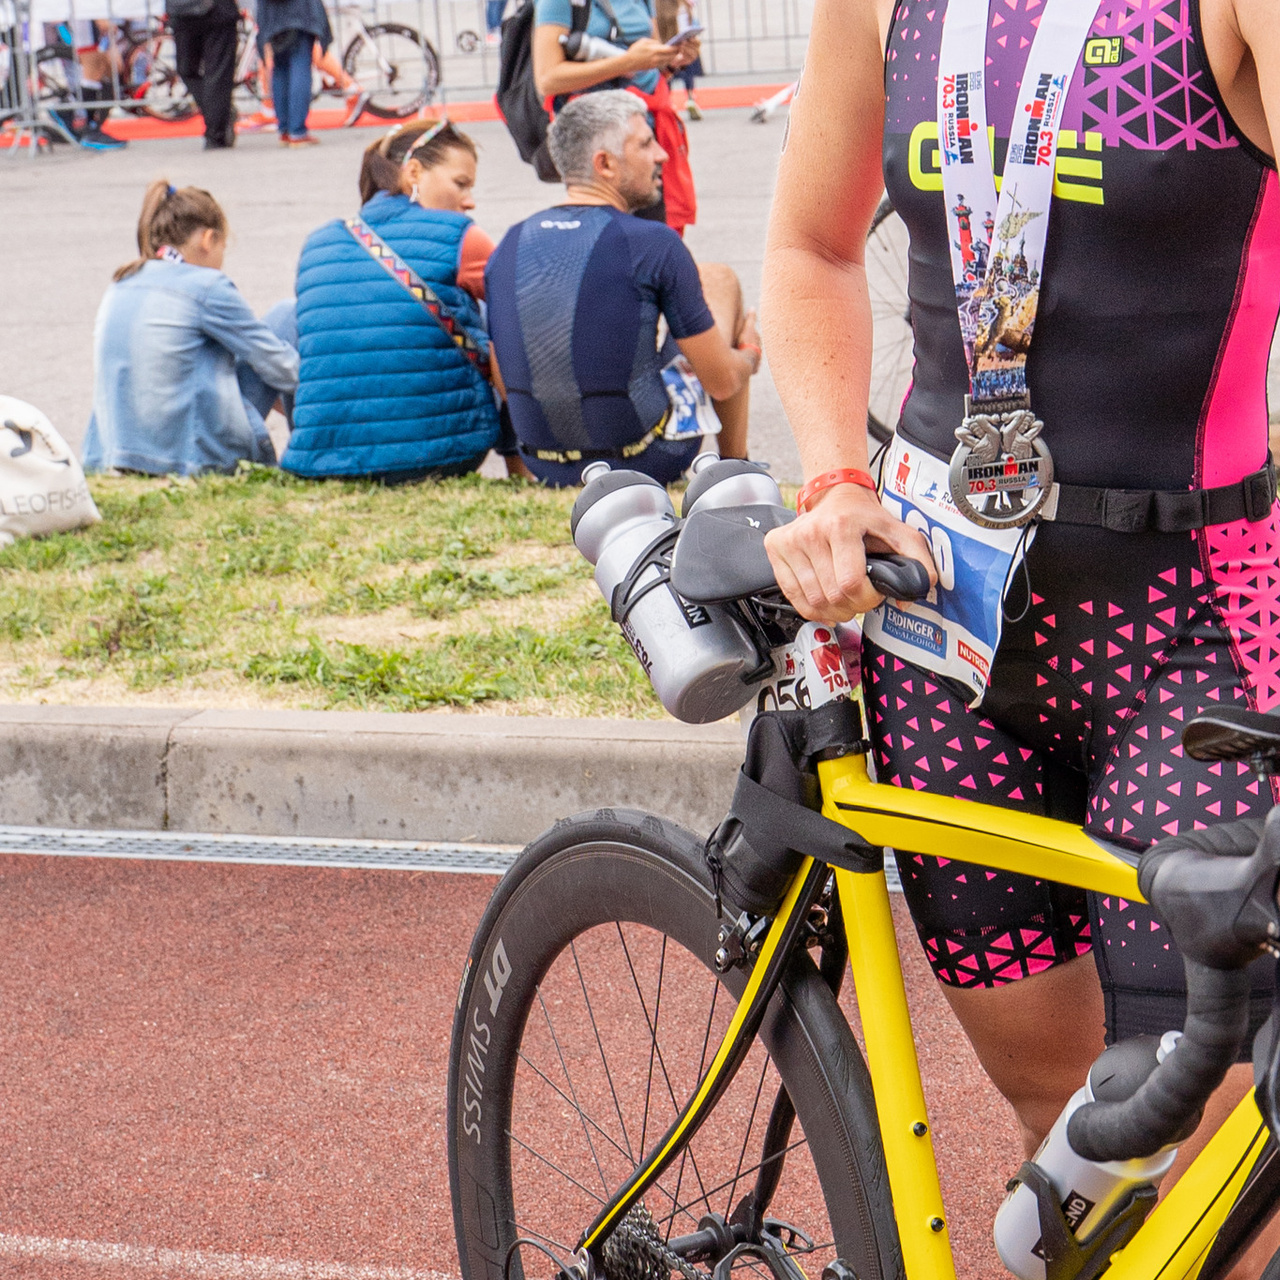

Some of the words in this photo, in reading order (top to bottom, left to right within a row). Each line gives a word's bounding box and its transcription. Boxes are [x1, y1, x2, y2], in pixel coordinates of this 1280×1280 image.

[942, 74, 955, 109] 70.3
[1043, 91, 1057, 127] RUSSIA
[948, 112, 956, 149] RUSSIA
[956, 73, 977, 164] IRONMAN
[1022, 73, 1053, 165] IRONMAN
[1036, 130, 1054, 166] 70.3
[968, 458, 1039, 480] IRONMAN
[969, 479, 996, 493] 70.3
[998, 476, 1027, 484] RUSSIA
[887, 607, 934, 640] ERDINGER
[484, 938, 513, 1017] DT
[463, 1007, 491, 1144] SWISS
